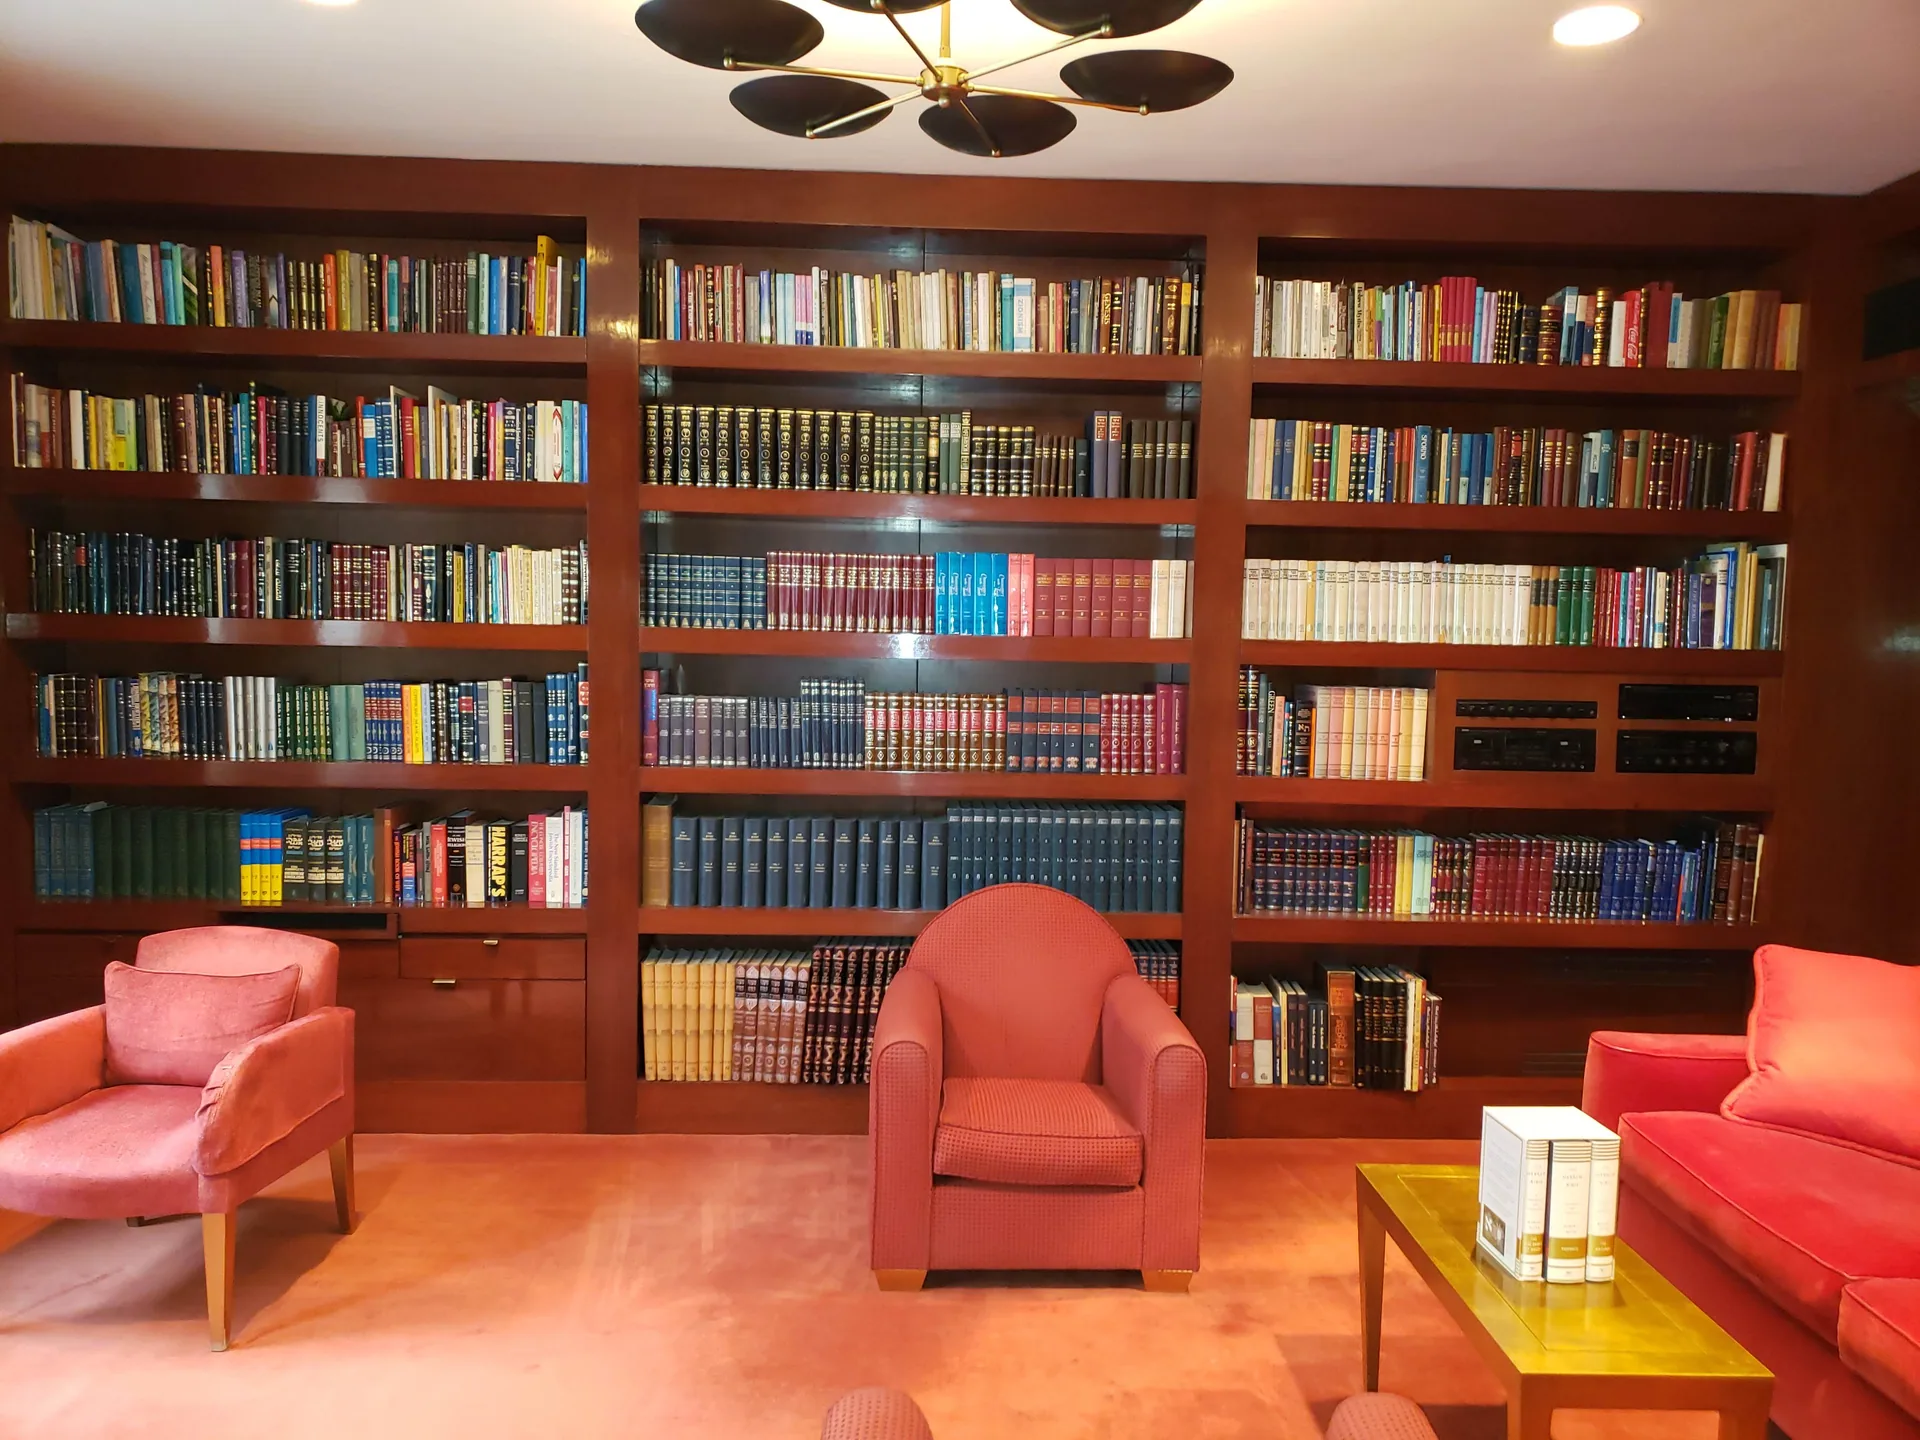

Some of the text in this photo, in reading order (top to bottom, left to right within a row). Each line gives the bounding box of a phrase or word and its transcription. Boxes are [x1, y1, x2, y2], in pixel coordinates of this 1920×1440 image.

[1420, 434, 1428, 460] SFORNO
[491, 826, 506, 897] HARRAP'S
[531, 821, 539, 875] ENCYCLOPEDIA
